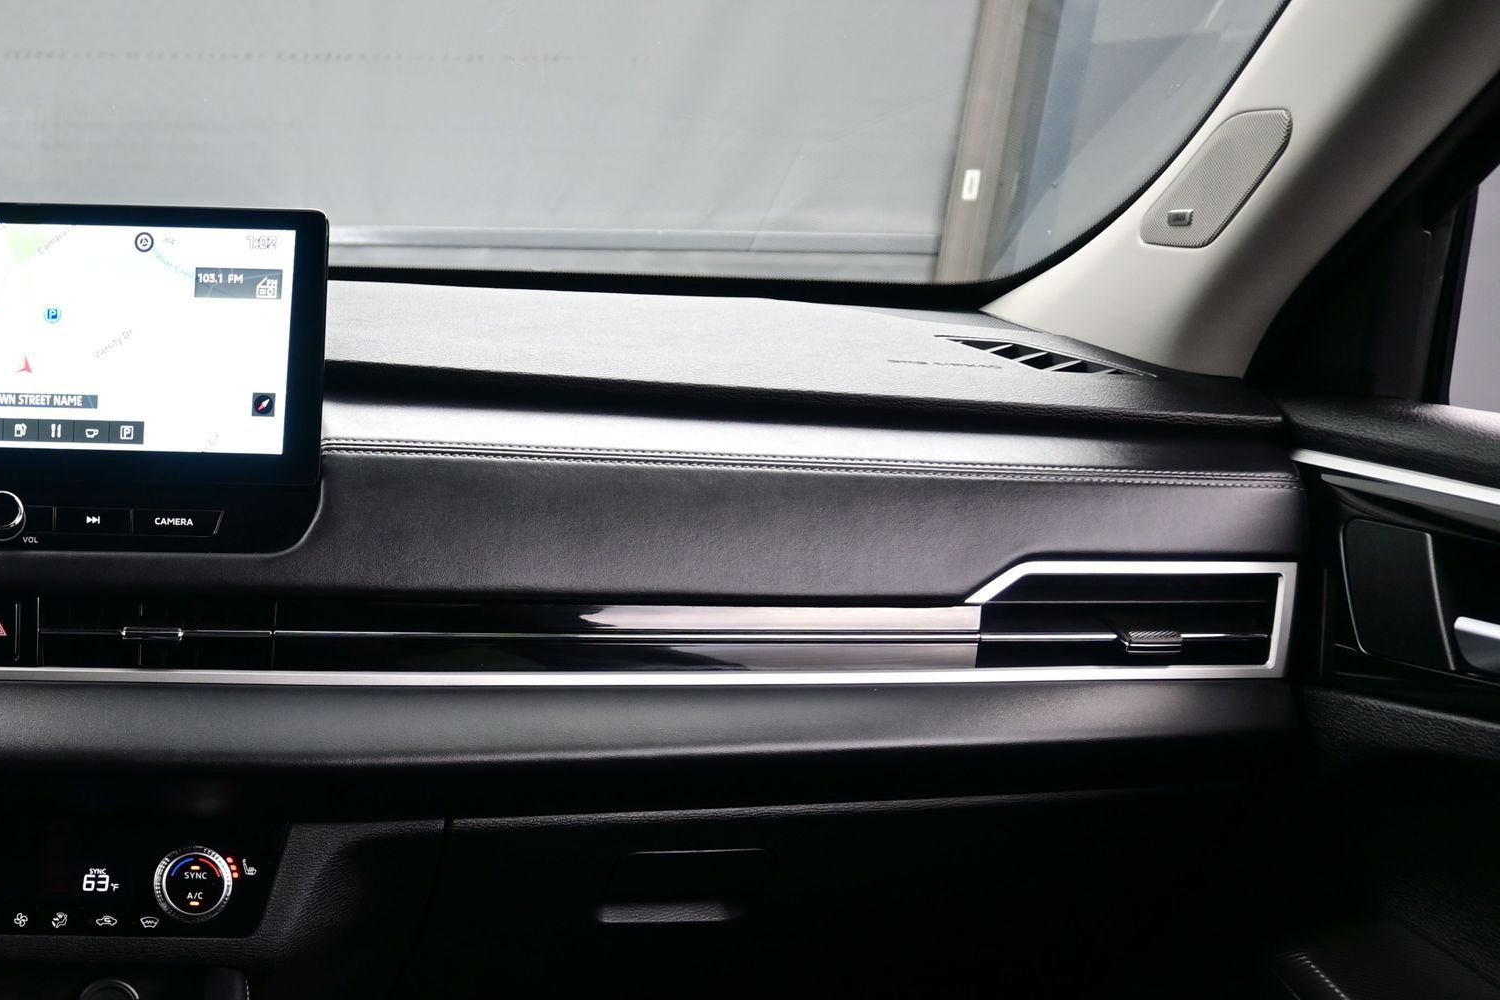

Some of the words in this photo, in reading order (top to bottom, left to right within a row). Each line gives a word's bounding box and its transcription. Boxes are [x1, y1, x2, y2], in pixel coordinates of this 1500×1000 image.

[247, 236, 278, 249] 1:02
[228, 274, 243, 285] FM
[18, 394, 51, 406] STREET
[53, 395, 83, 407] NAME
[154, 516, 194, 526] CAMERA
[23, 535, 39, 544] VOL
[184, 871, 208, 880] SYNC
[186, 891, 204, 900] A/C
